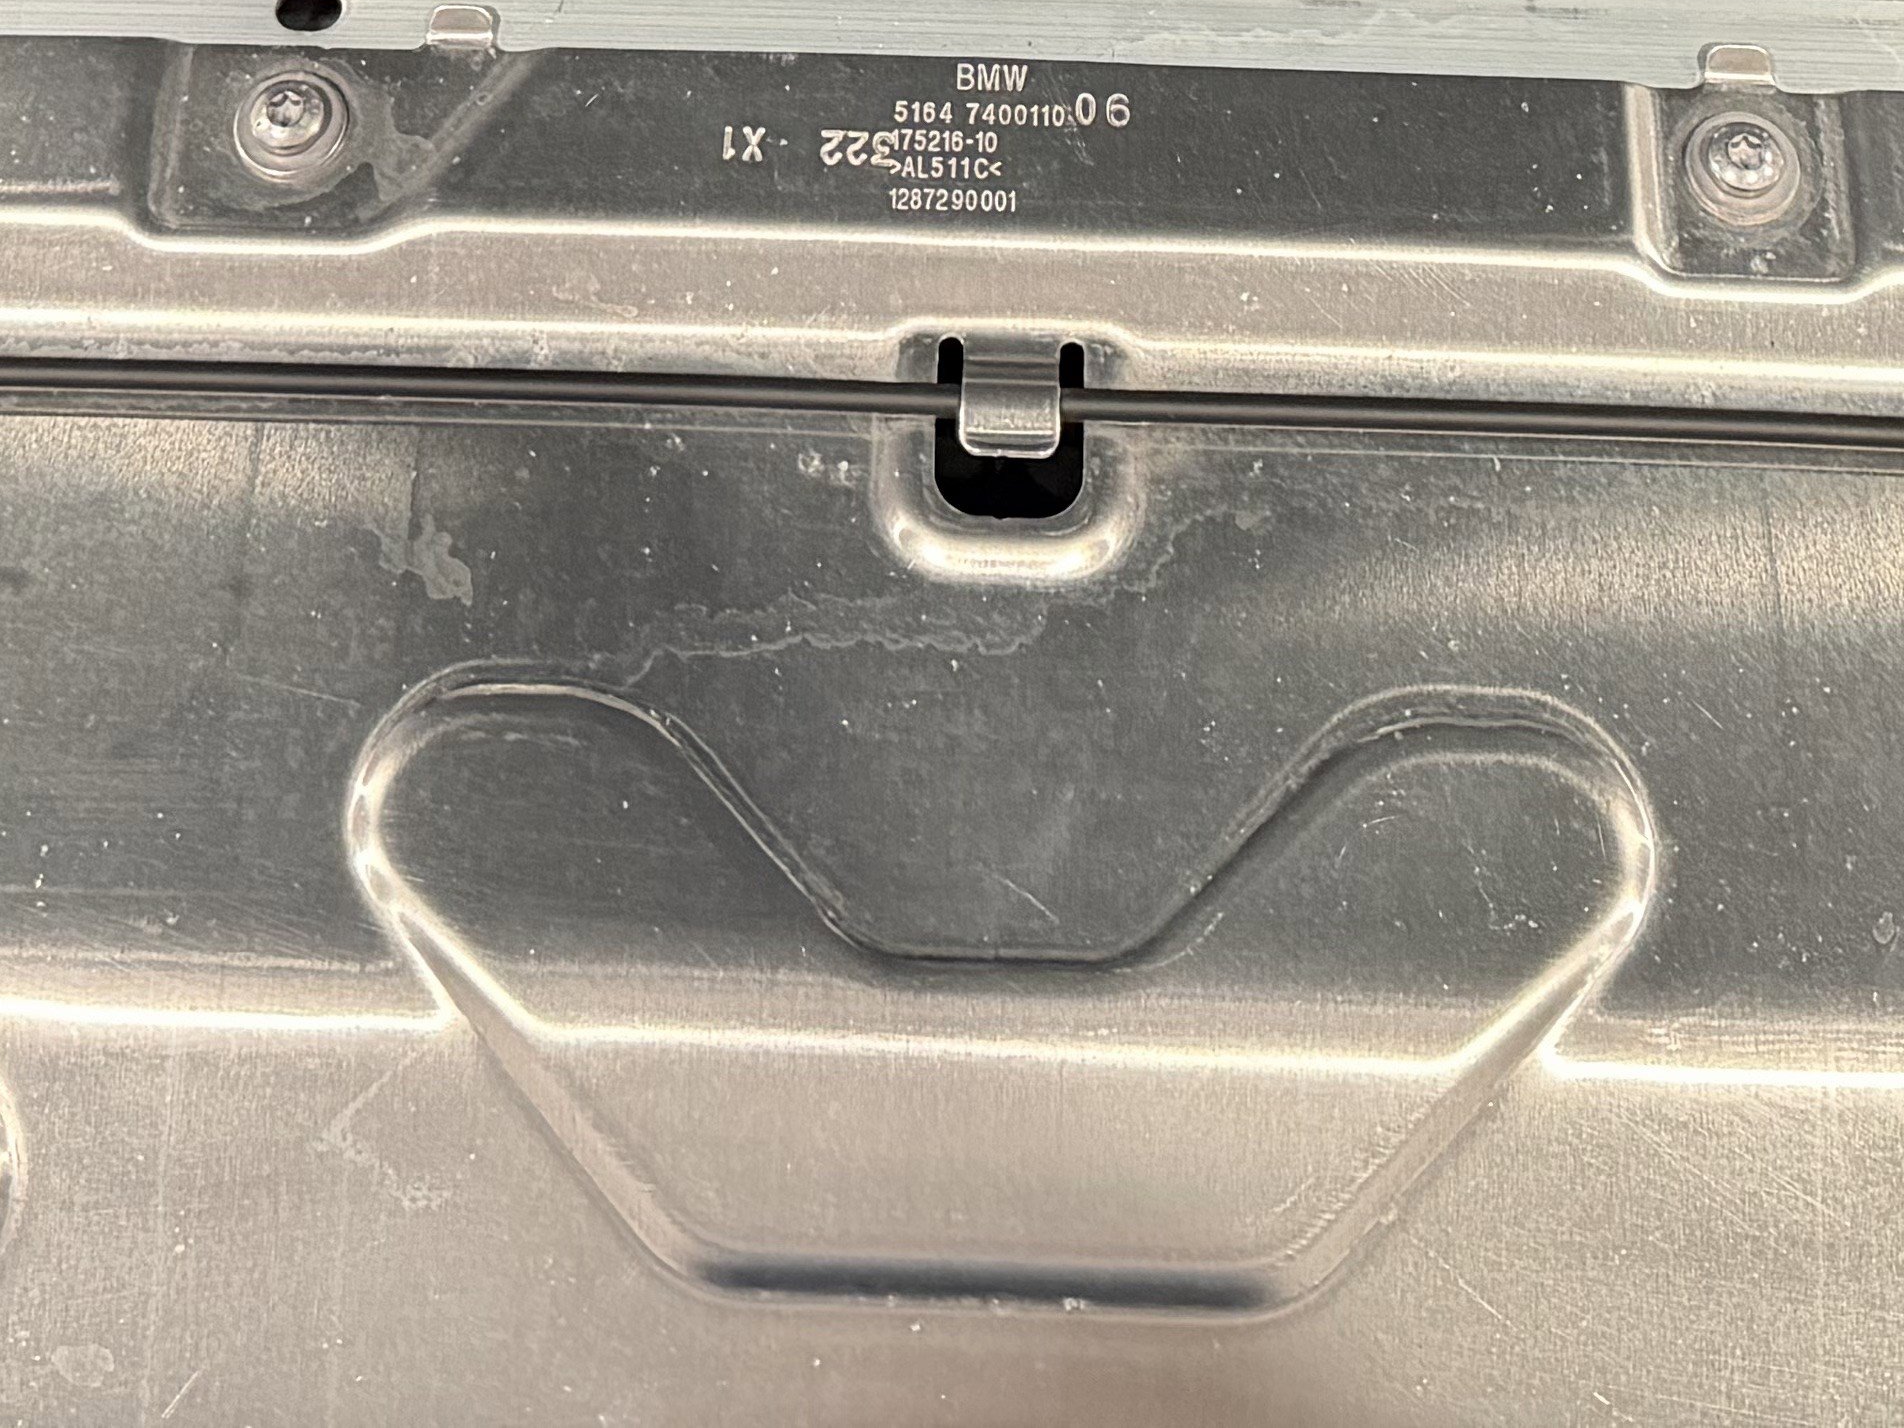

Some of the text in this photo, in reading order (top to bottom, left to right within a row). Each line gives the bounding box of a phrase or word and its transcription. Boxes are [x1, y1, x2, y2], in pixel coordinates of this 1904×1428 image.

[955, 62, 1029, 93] BMW
[893, 91, 1132, 129] 5164 7400110 06
[721, 124, 899, 169] 322 X1
[888, 156, 1003, 182] >AL511C<
[888, 187, 1017, 213] 1287290001
